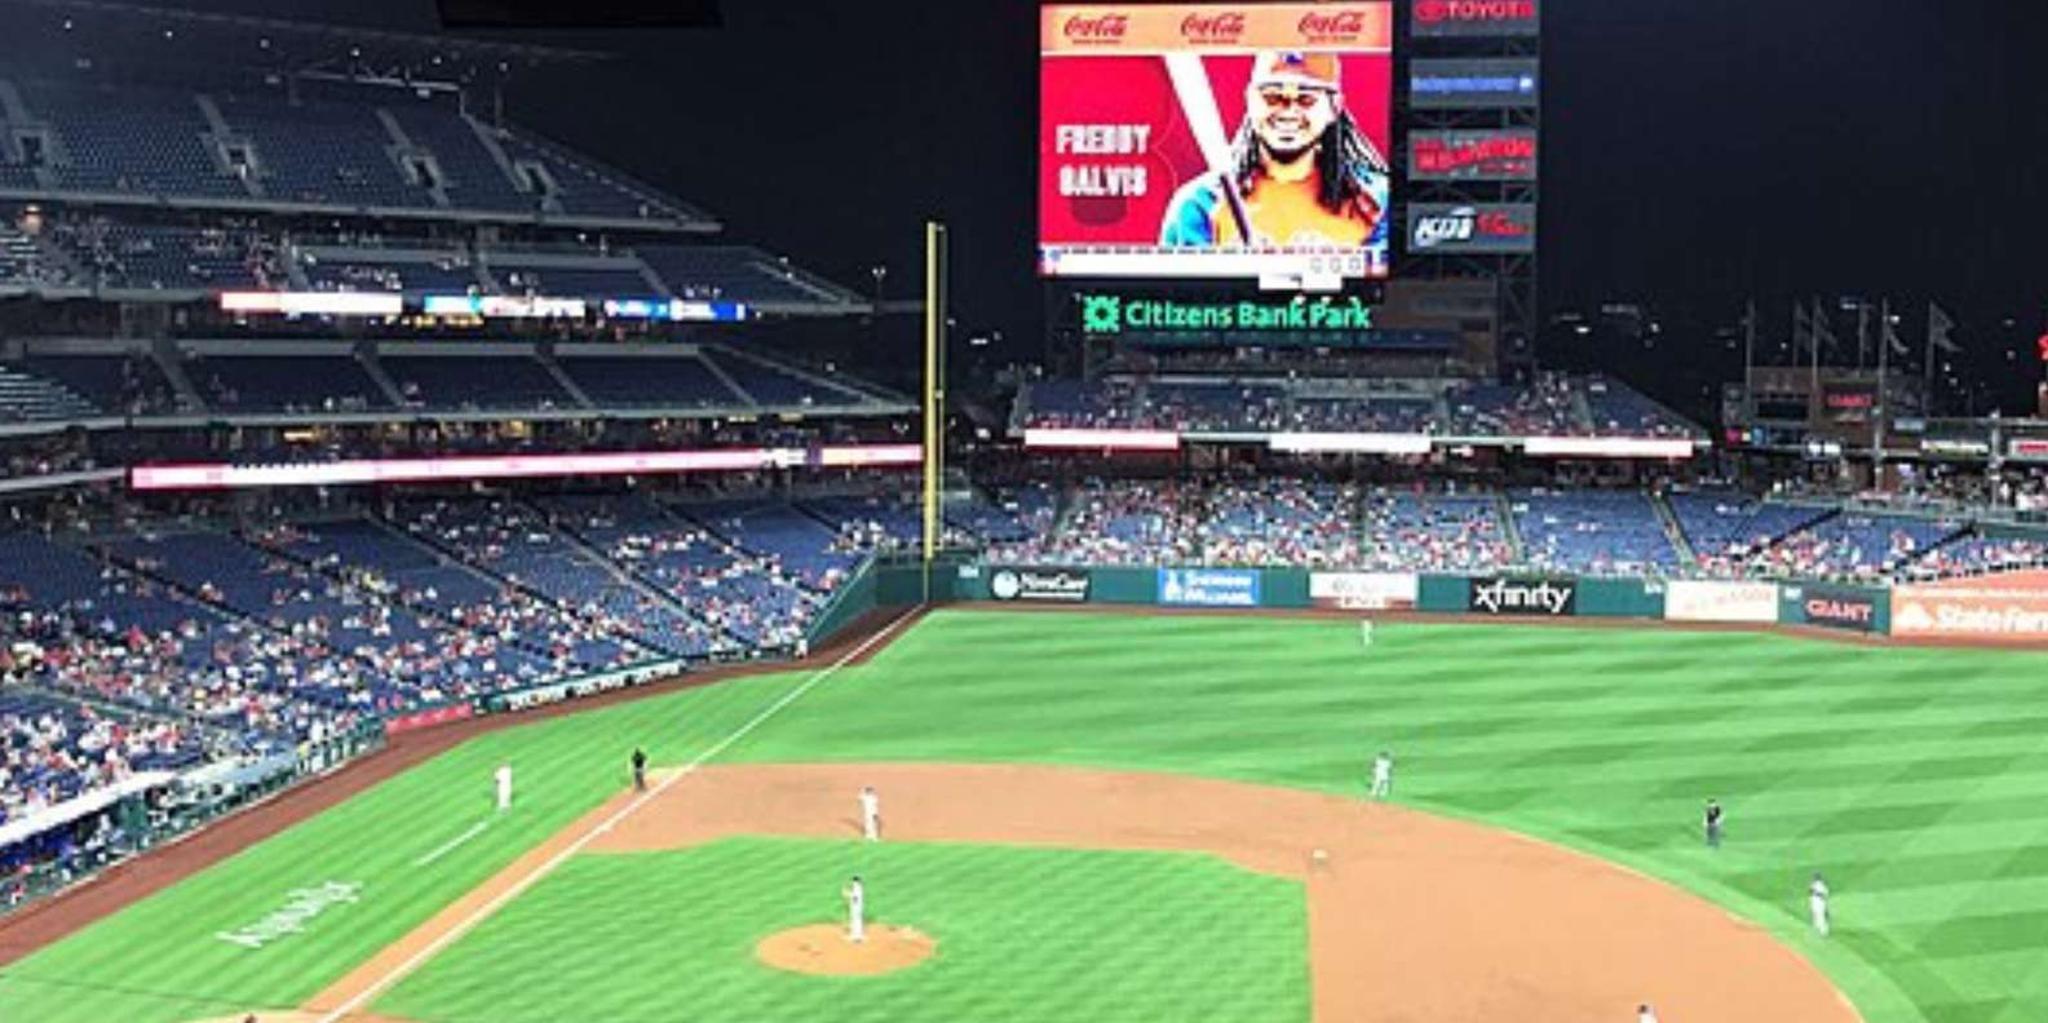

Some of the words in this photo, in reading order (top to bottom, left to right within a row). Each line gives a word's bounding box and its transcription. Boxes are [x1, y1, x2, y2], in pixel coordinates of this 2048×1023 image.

[1063, 12, 1129, 37] Coca-Cola
[1180, 11, 1245, 37] Coca-Cola
[1297, 11, 1366, 34] Coca-Cola
[1125, 301, 1233, 328] Citizens
[1238, 301, 1306, 328] Bank
[1308, 299, 1372, 328] Park
[1475, 577, 1572, 613] xfinity
[1805, 599, 1874, 621] GIANT
